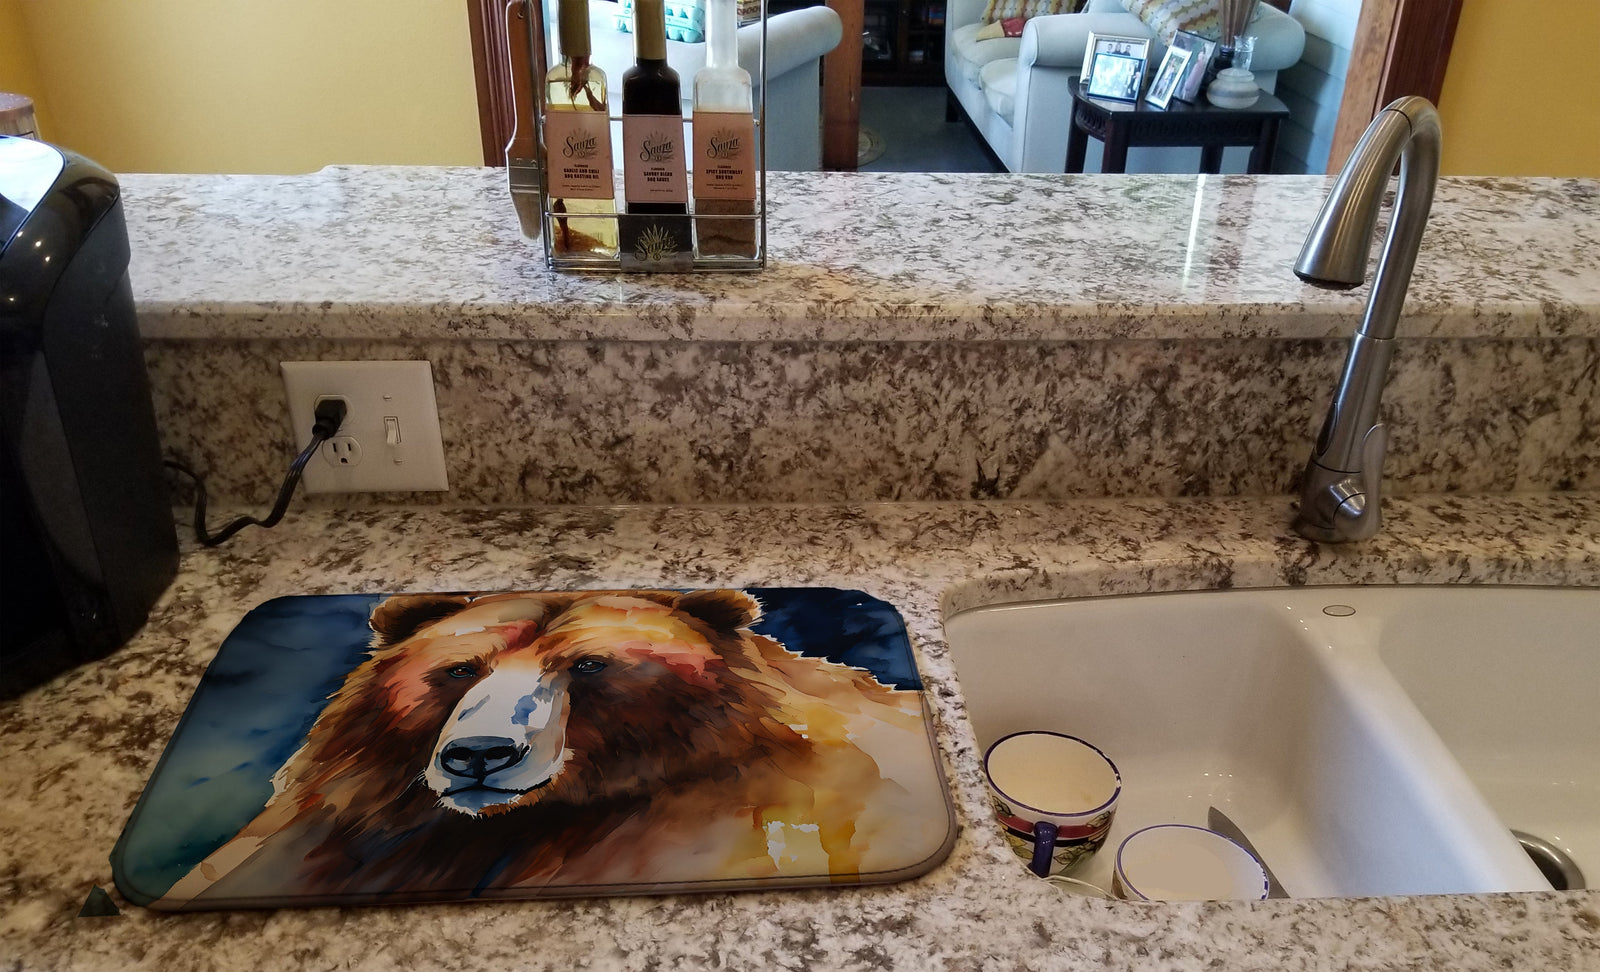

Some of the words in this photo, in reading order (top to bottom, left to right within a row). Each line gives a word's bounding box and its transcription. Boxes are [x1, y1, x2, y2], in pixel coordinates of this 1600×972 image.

[563, 136, 597, 158] Sauza
[640, 140, 673, 161] Sauza
[706, 137, 740, 158] Sauza
